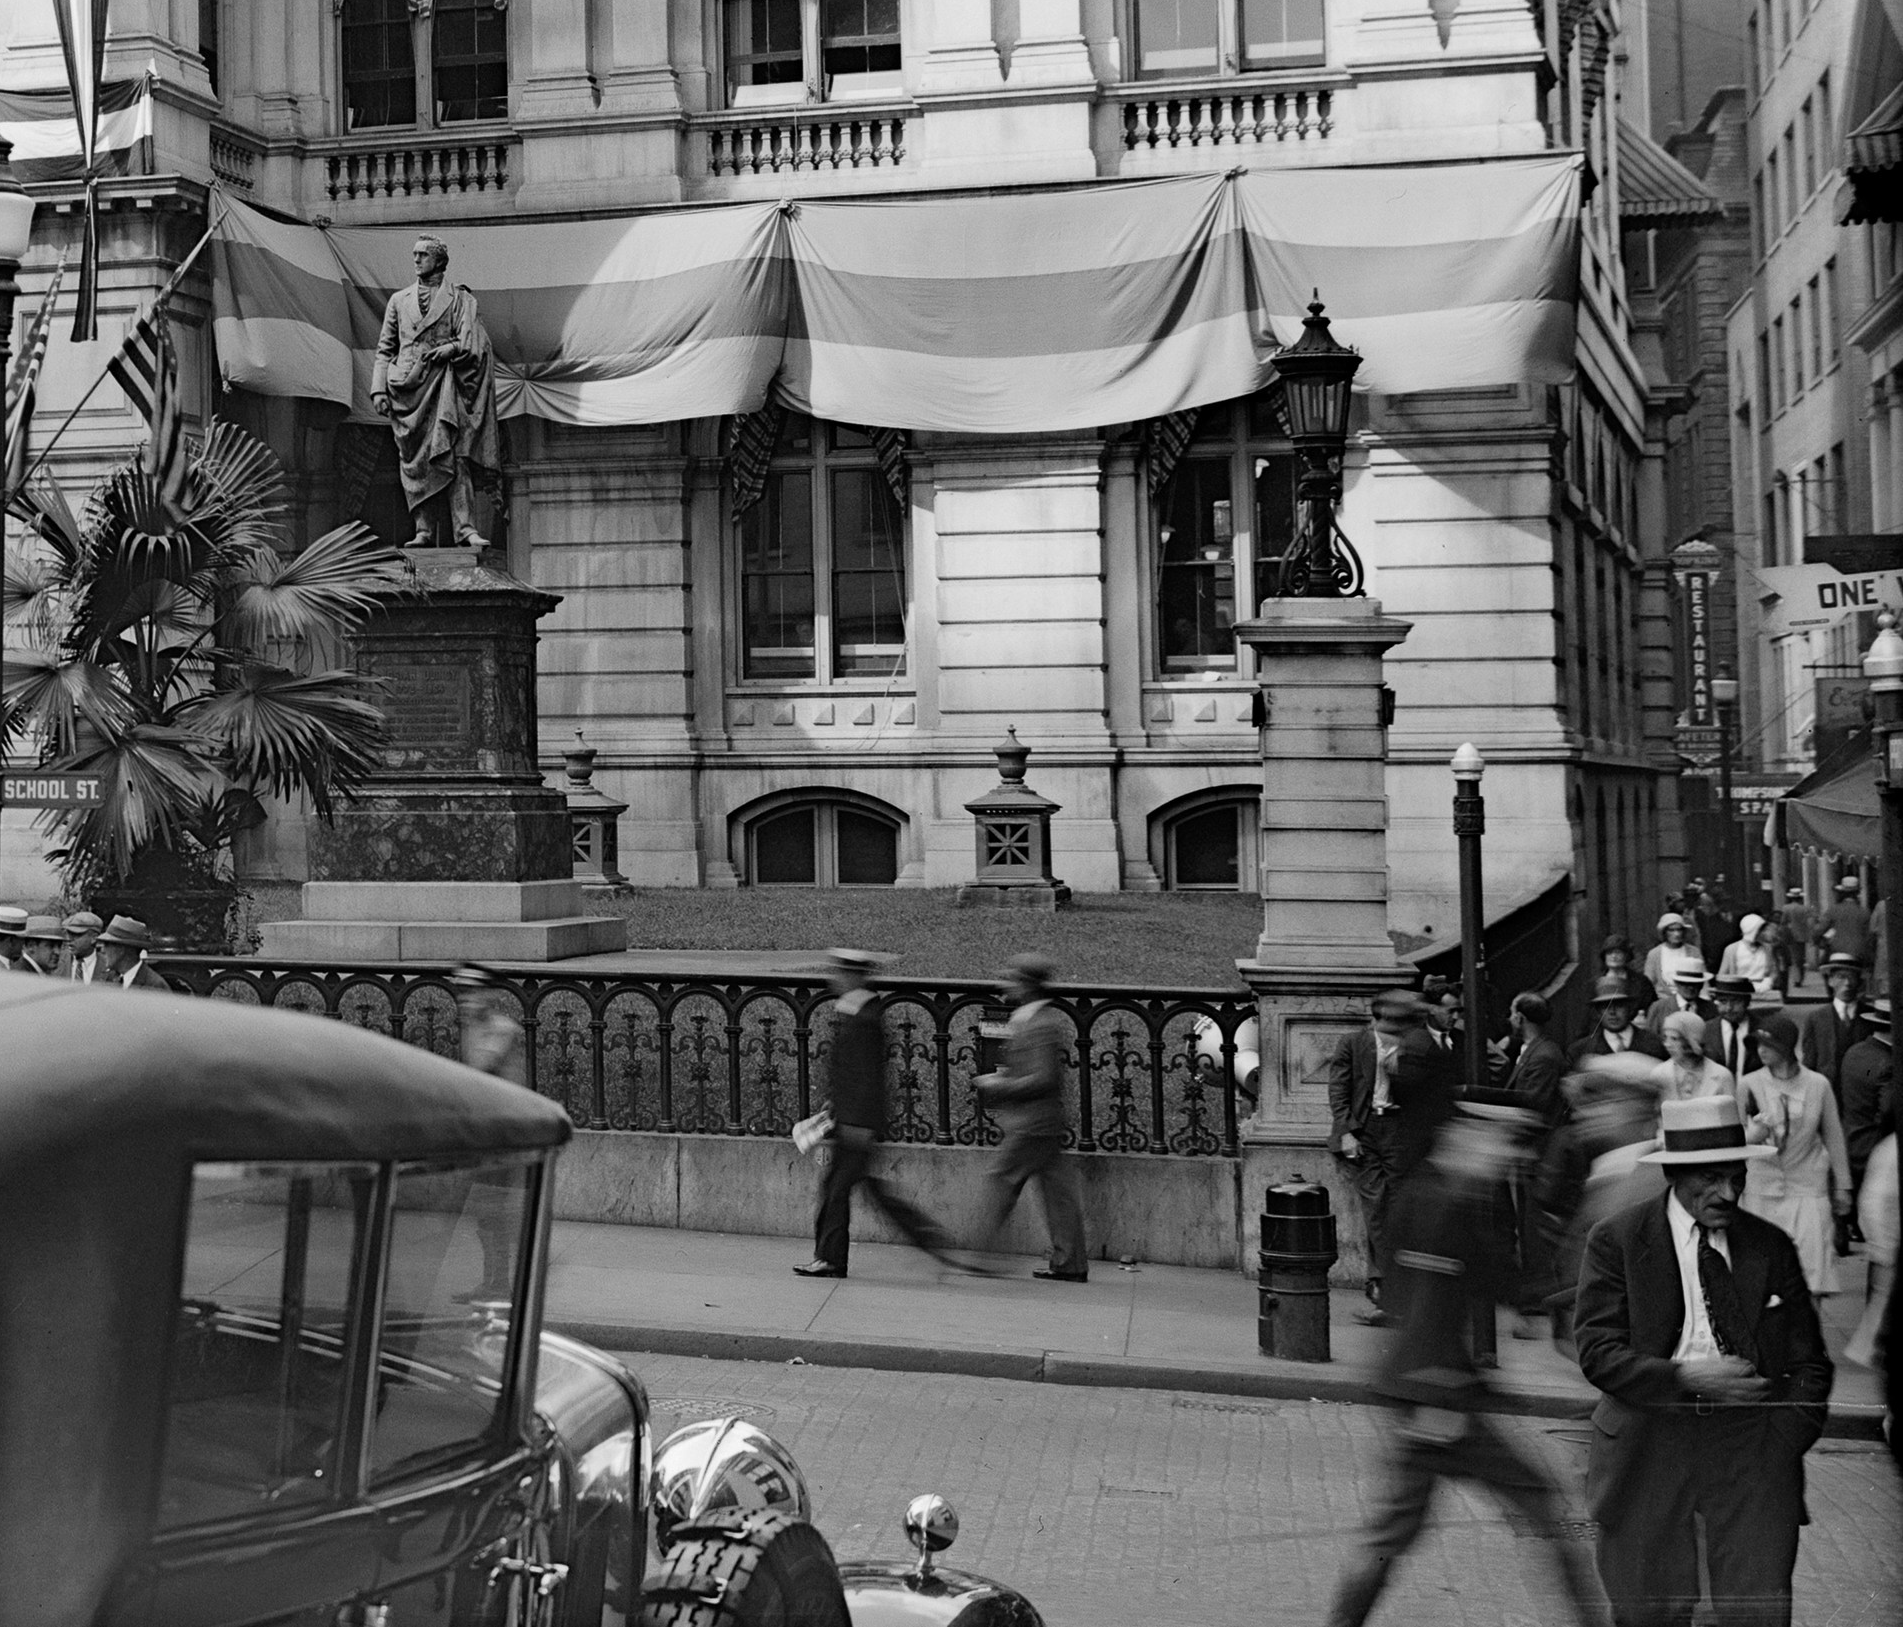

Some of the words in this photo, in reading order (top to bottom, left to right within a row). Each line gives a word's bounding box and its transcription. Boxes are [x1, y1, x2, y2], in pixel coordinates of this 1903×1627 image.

[1817, 578, 1879, 609] ONE
[1690, 575, 1707, 721] RESTAURANT
[4, 779, 70, 799] SCHOOL
[76, 779, 101, 800] ST.
[1715, 786, 1793, 799] TOMPSON
[1740, 801, 1772, 814] SPA
